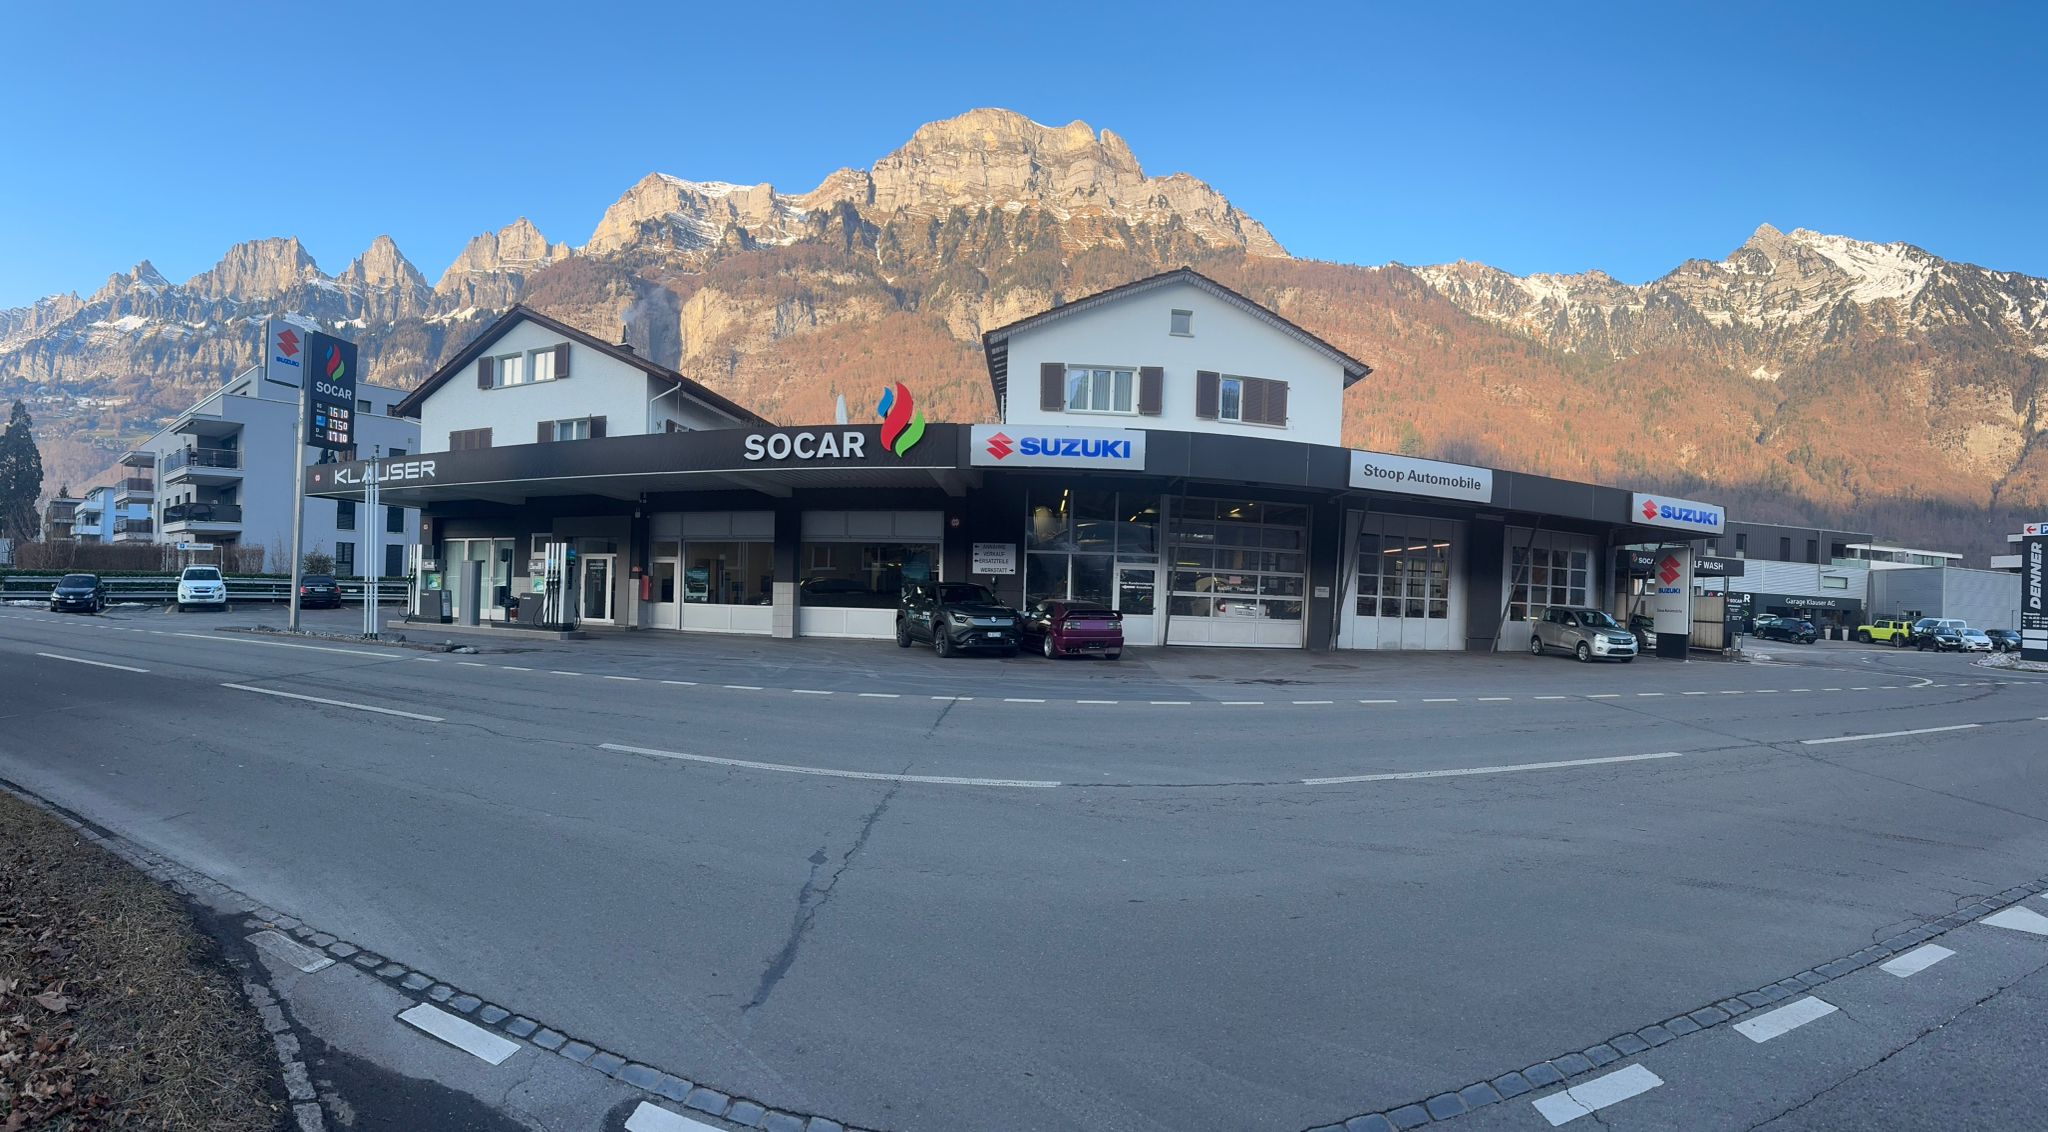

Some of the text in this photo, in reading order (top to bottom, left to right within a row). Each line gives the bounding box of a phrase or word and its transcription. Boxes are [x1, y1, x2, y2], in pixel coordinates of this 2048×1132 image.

[316, 381, 352, 401] SOCAR
[743, 431, 866, 461] SOCAR
[1020, 437, 1131, 459] SUZUKI
[1363, 463, 1482, 490] Stoop Automobile
[1660, 505, 1718, 526] SUZUKI
[1703, 561, 1724, 570] WASH
[2030, 541, 2043, 610] DENNER
[1785, 597, 1805, 606] Garage
